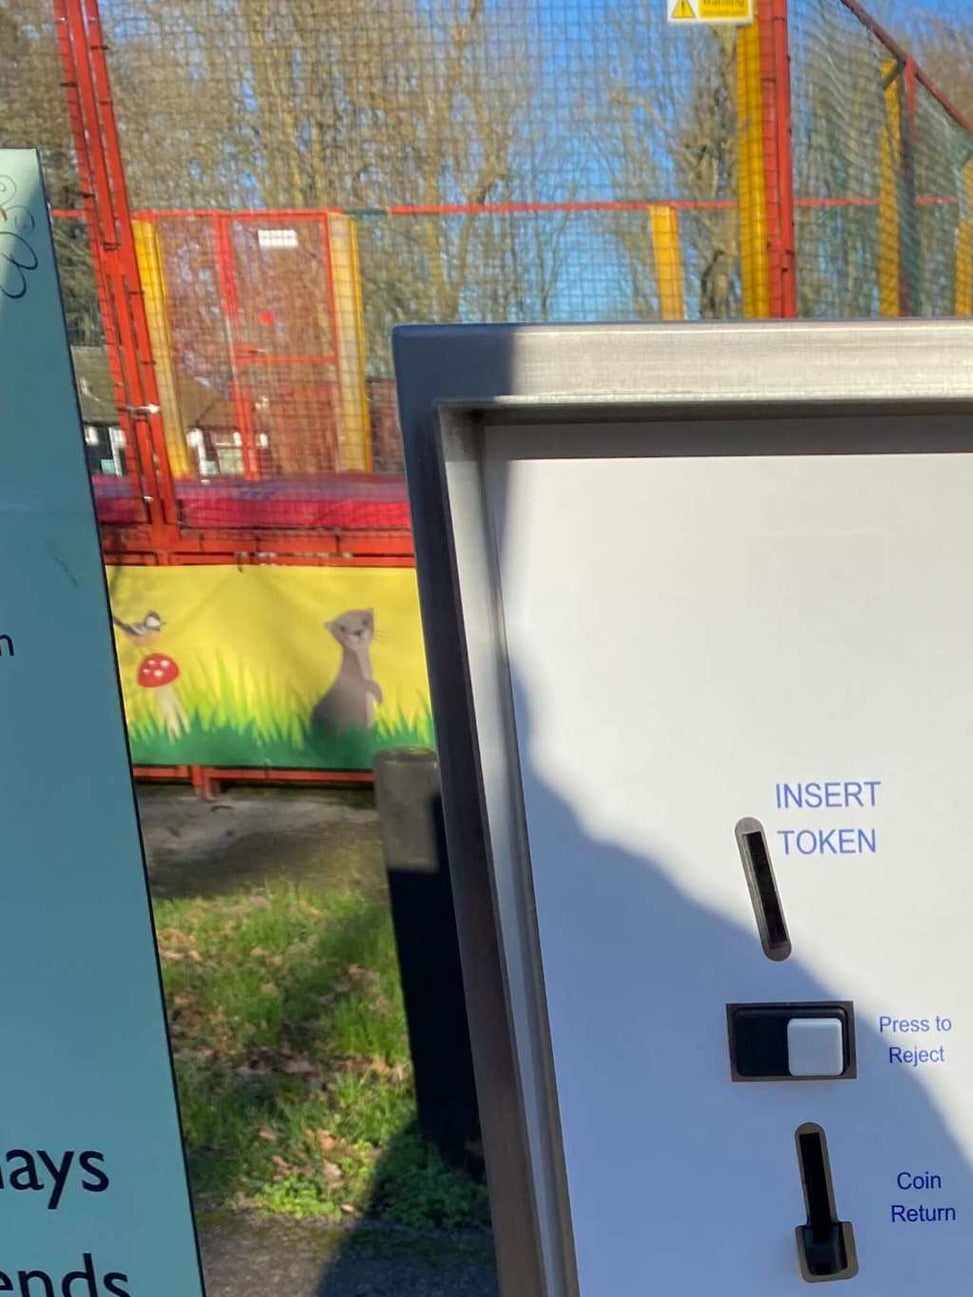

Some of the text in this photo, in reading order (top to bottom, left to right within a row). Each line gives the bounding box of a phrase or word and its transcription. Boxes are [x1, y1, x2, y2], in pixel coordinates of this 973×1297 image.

[775, 781, 881, 808] INSERT
[777, 828, 877, 855] TOKEN
[879, 1015, 953, 1033] Press to
[888, 1045, 946, 1068] Reject
[897, 1171, 943, 1190] Coin
[890, 1204, 957, 1223] Return
